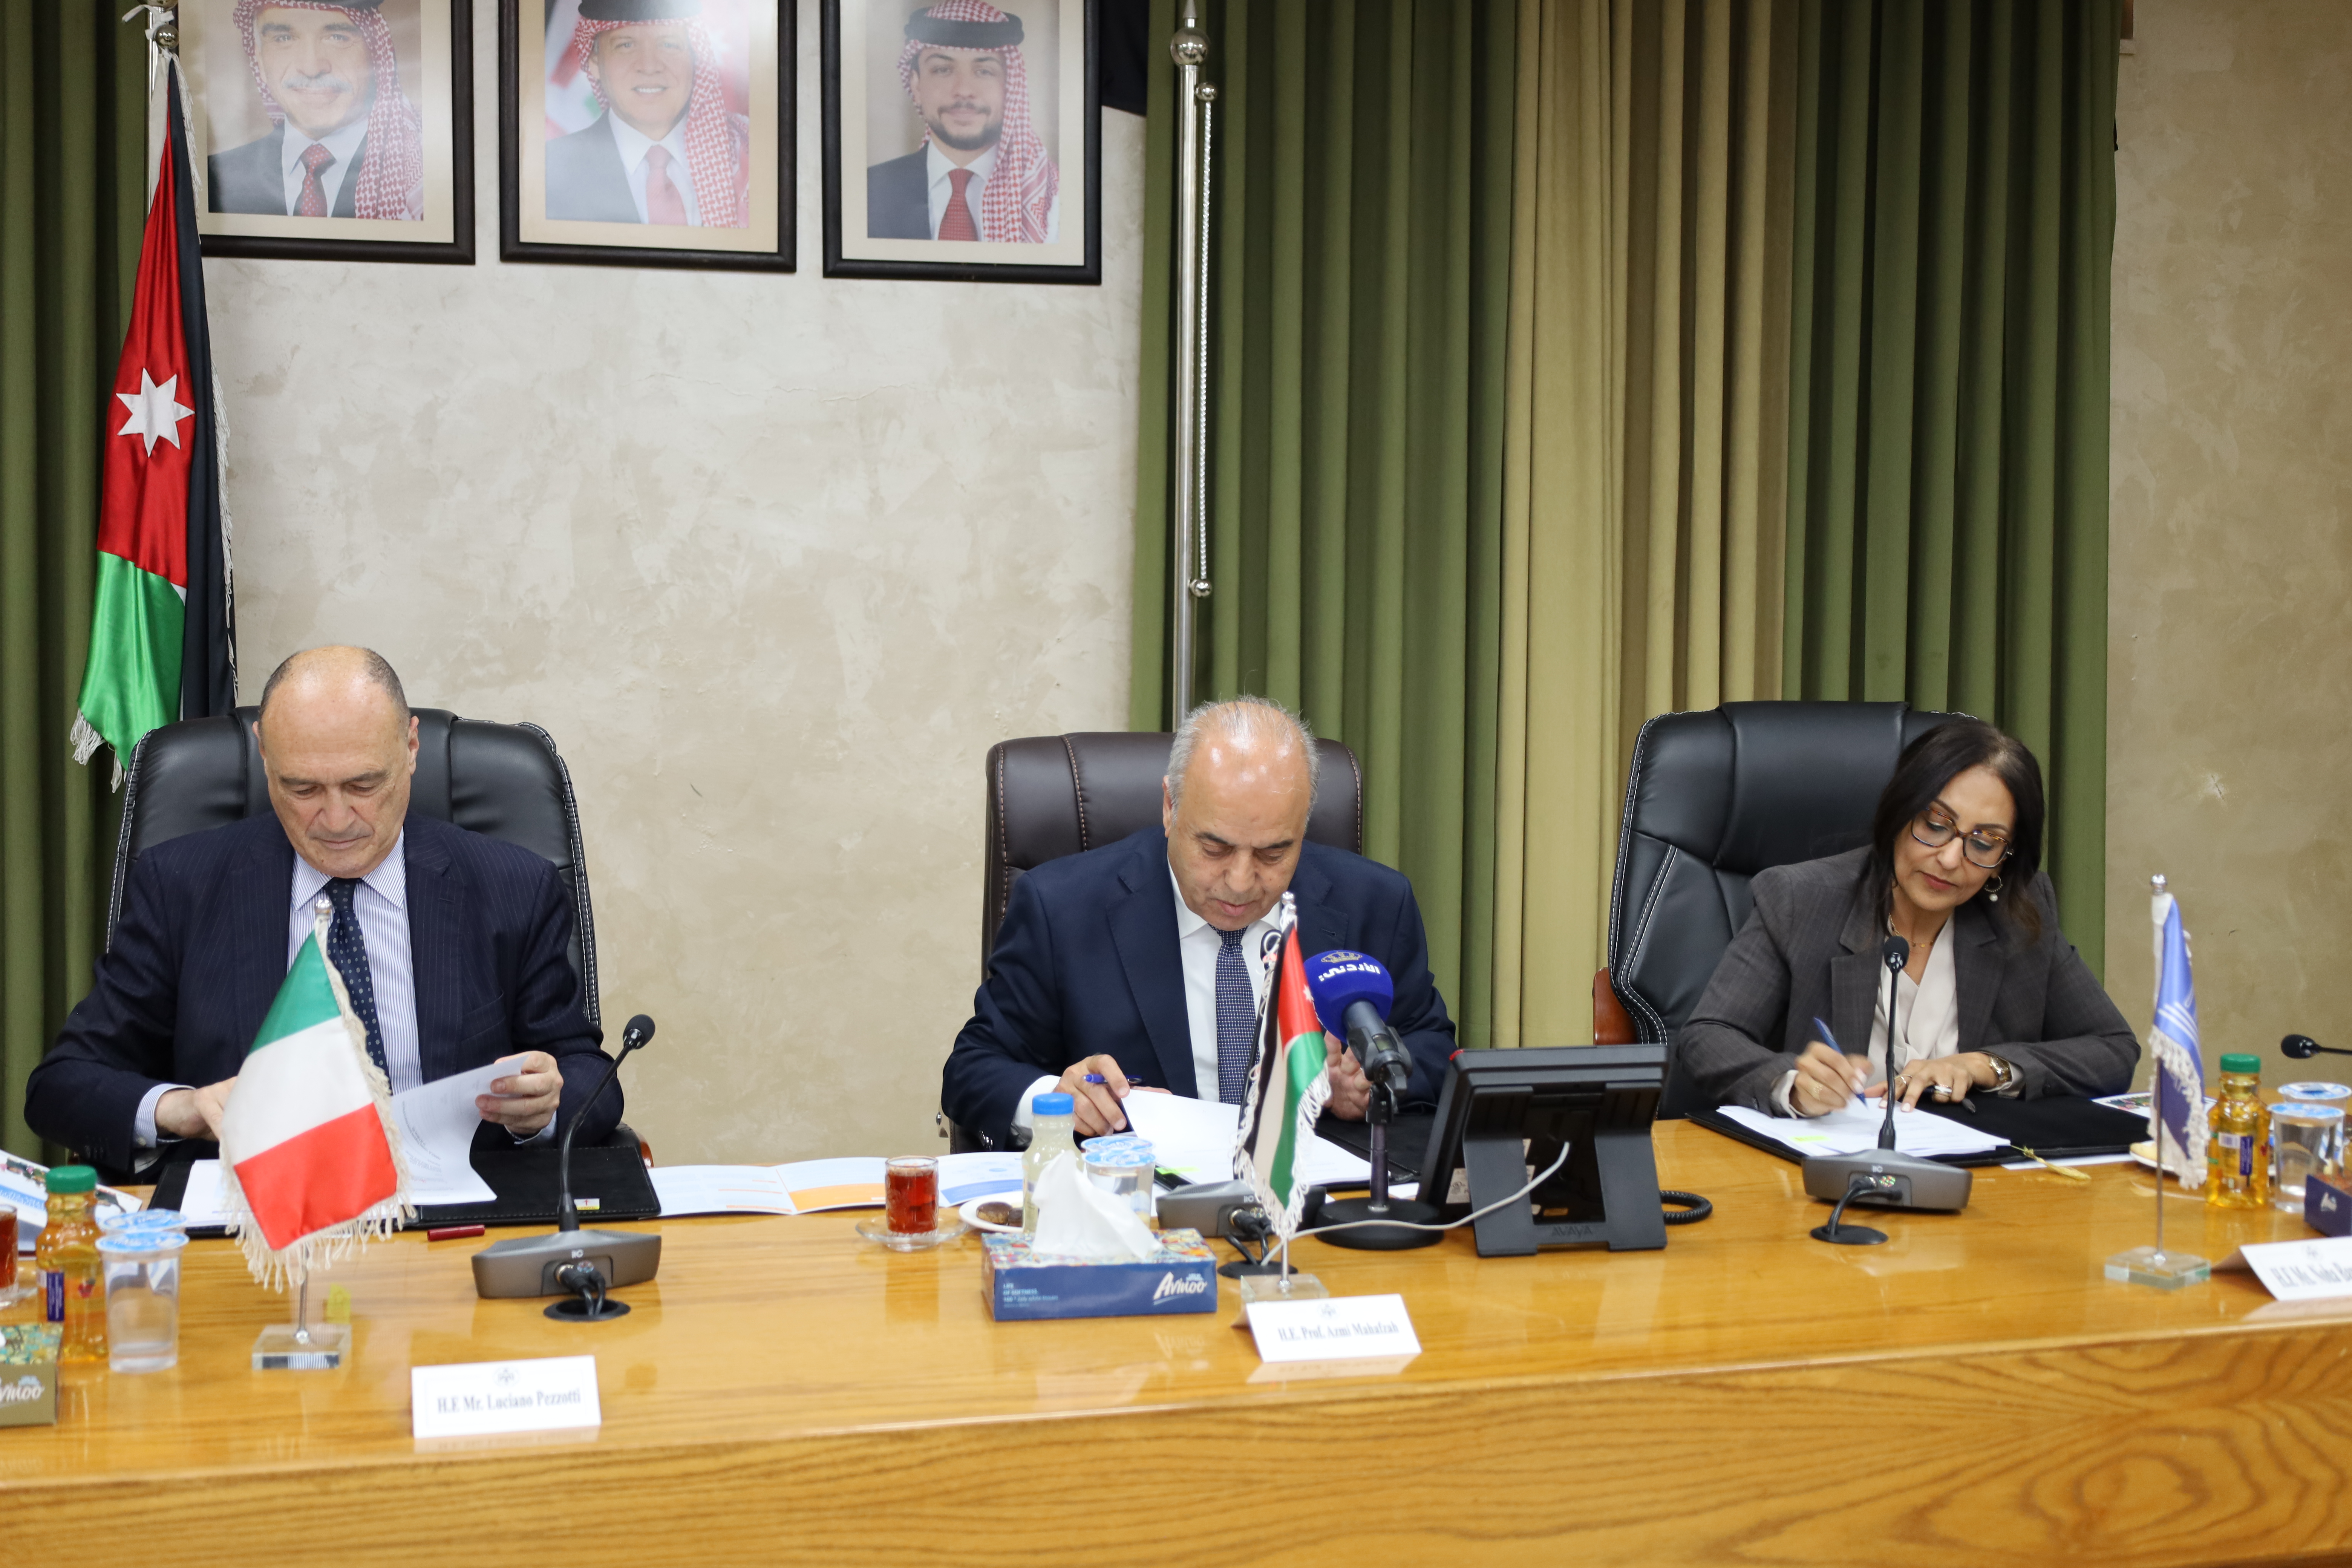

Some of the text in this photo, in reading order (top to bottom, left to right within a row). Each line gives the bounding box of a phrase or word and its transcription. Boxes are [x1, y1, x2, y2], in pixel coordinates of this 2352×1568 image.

[1551, 1225, 1593, 1238] AVAYA
[486, 1392, 533, 1410] Luciano
[536, 1387, 581, 1407] Pezzotti
